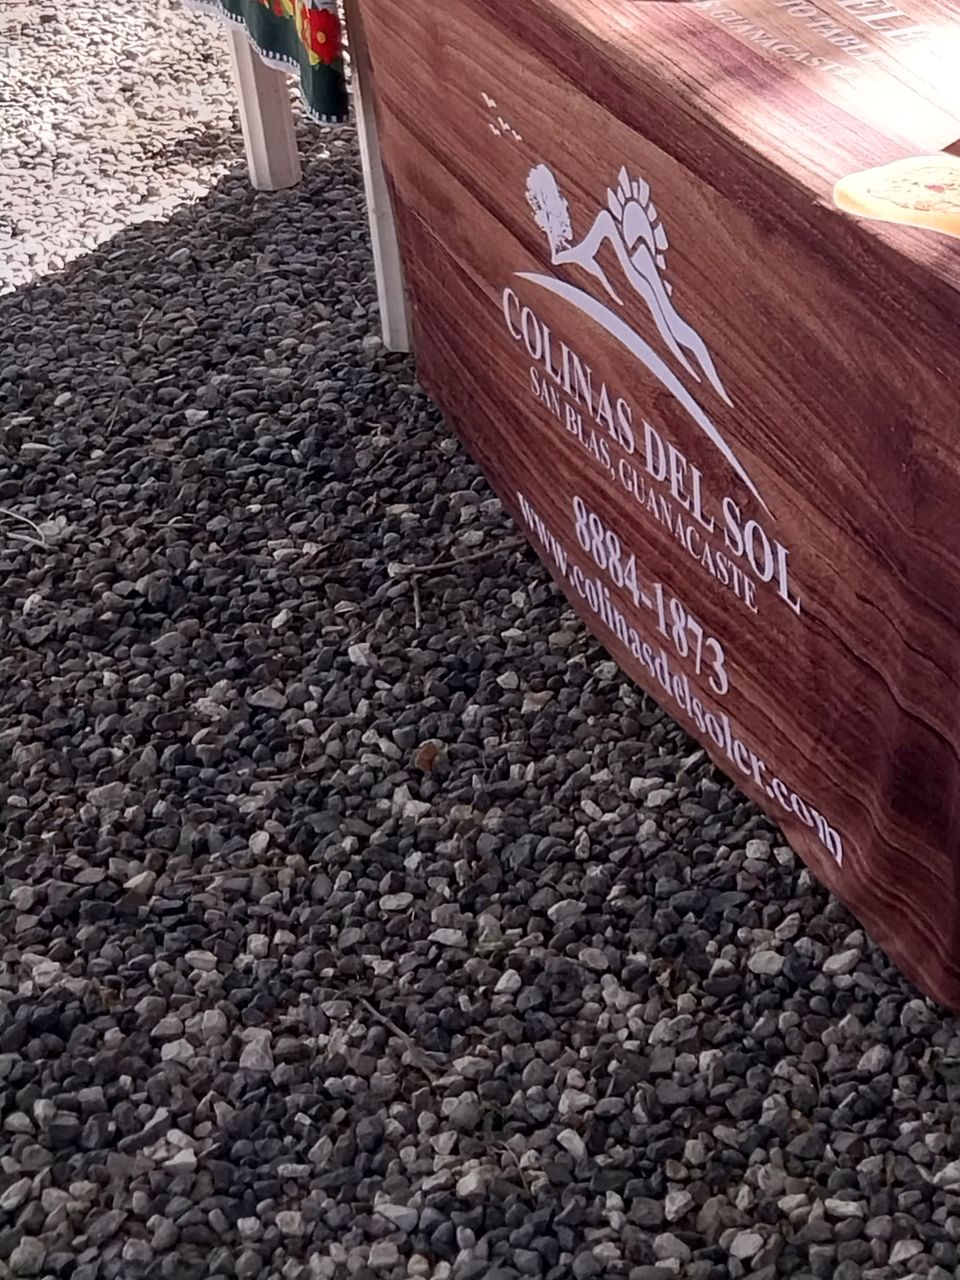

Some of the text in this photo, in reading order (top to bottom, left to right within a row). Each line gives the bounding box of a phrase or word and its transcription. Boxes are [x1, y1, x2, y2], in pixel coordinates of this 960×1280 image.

[503, 287, 801, 616] COLINAS DEL SOL
[530, 366, 760, 615] SAN BLAS, GUANACASTE
[572, 495, 729, 696] 8884-1873
[516, 491, 845, 870] www.colinasdelsolcr.com
